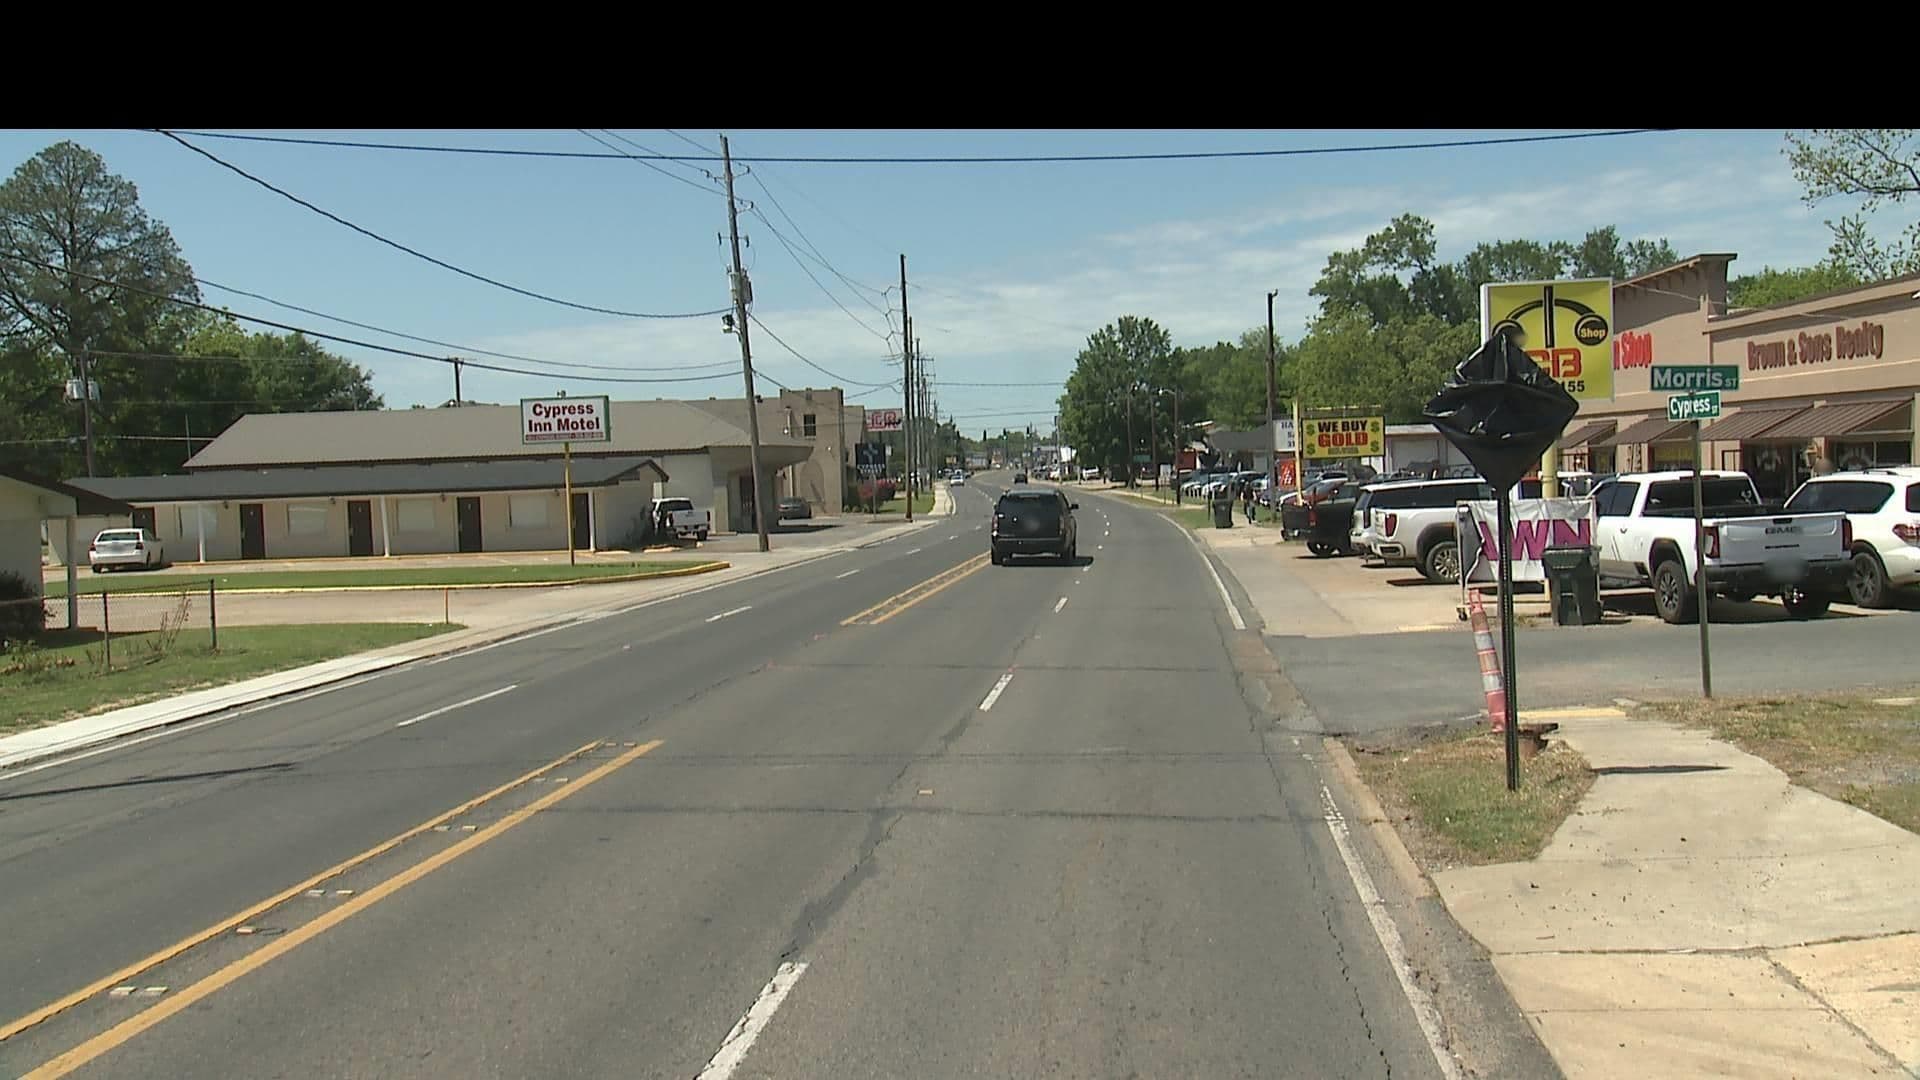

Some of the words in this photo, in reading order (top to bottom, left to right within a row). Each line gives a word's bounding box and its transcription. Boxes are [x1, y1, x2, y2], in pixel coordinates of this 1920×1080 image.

[1580, 327, 1606, 340] Shop
[1621, 330, 1653, 370] Shop
[1747, 341, 1786, 371] Brown
[1787, 338, 1797, 366] &
[1798, 331, 1832, 364] Sons
[1836, 320, 1884, 360] Realty
[1653, 367, 1723, 389] Morris
[1724, 378, 1737, 388] ST
[532, 402, 594, 418] Cypress
[1670, 397, 1711, 418] Cypress
[528, 419, 552, 432] Inn
[557, 417, 600, 431] Motel
[1317, 421, 1338, 433] WE
[1341, 420, 1367, 432] BUY
[1318, 432, 1368, 447] GOLD
